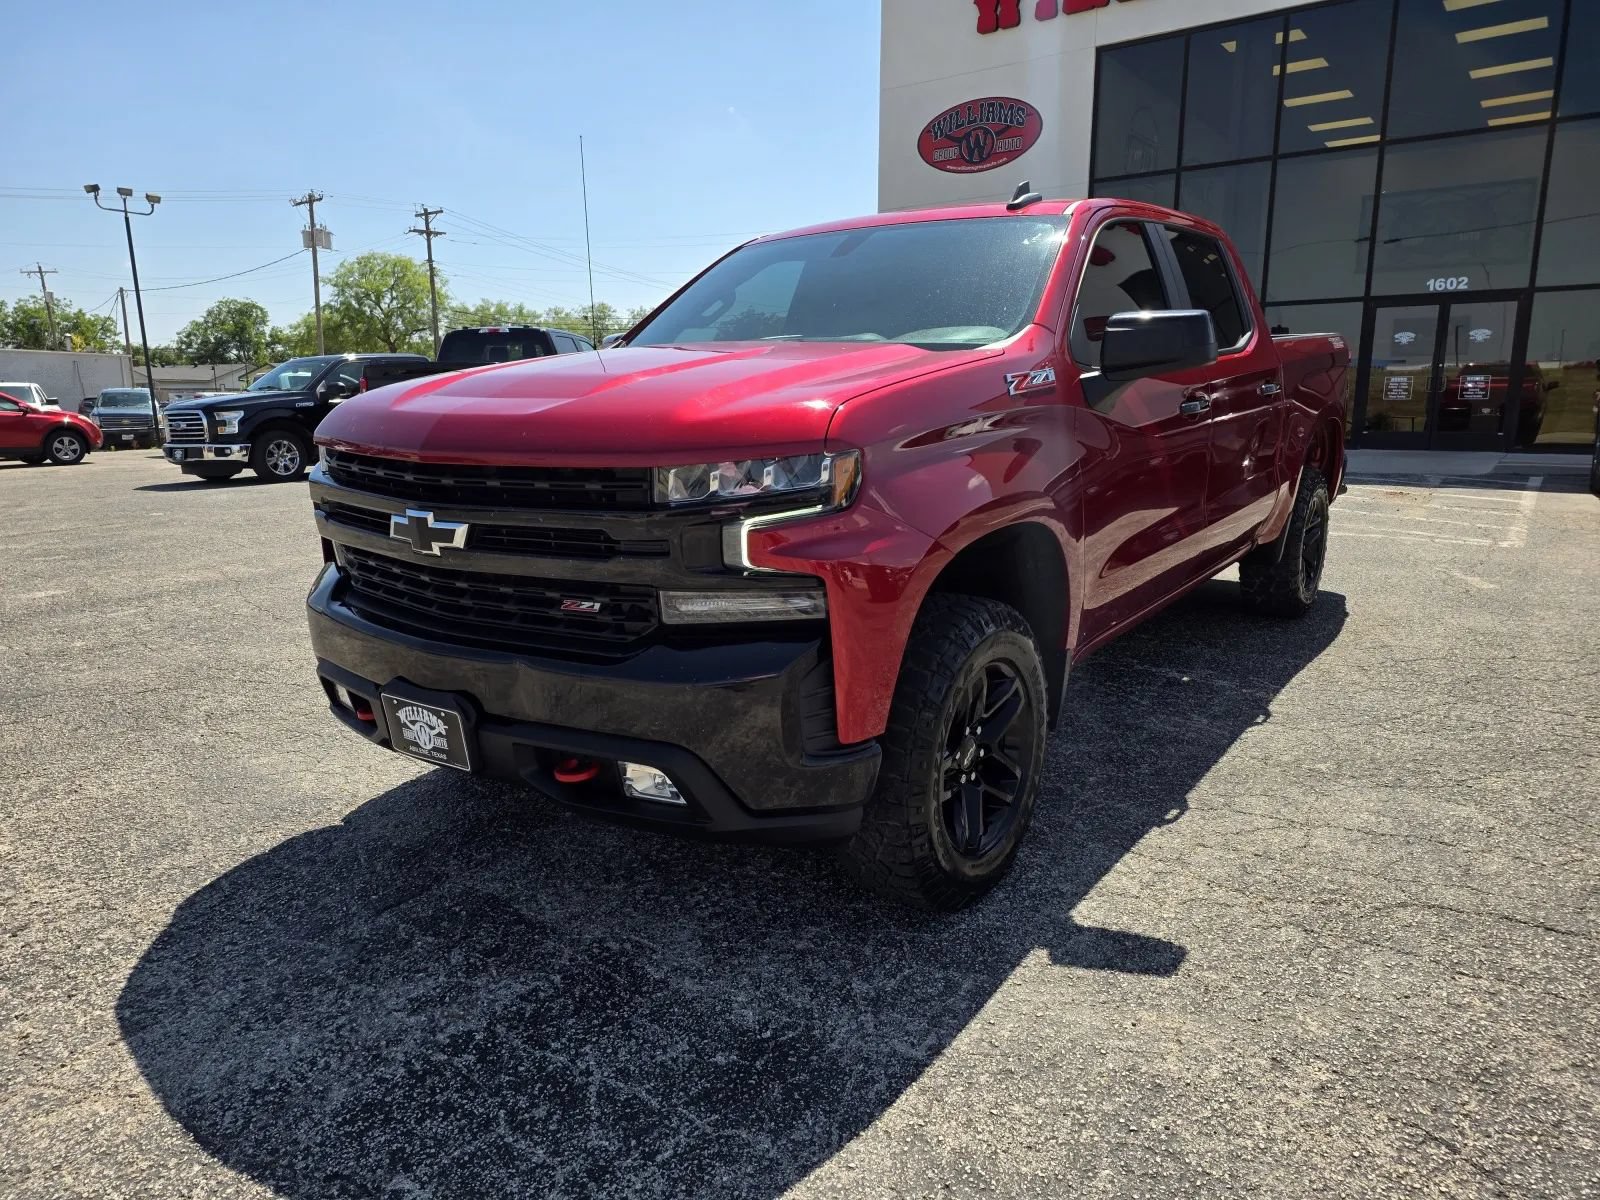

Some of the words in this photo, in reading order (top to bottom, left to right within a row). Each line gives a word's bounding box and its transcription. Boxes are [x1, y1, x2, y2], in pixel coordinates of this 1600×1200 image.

[931, 101, 1027, 142] WILLIAMS
[933, 146, 960, 162] GROUP
[963, 128, 991, 162] W
[996, 137, 1023, 153] AUTO
[1426, 276, 1469, 292] 1602
[1004, 367, 1057, 396] Z71
[560, 599, 601, 613] Z71
[398, 705, 447, 736] WILLIAMS
[415, 723, 434, 749] W
